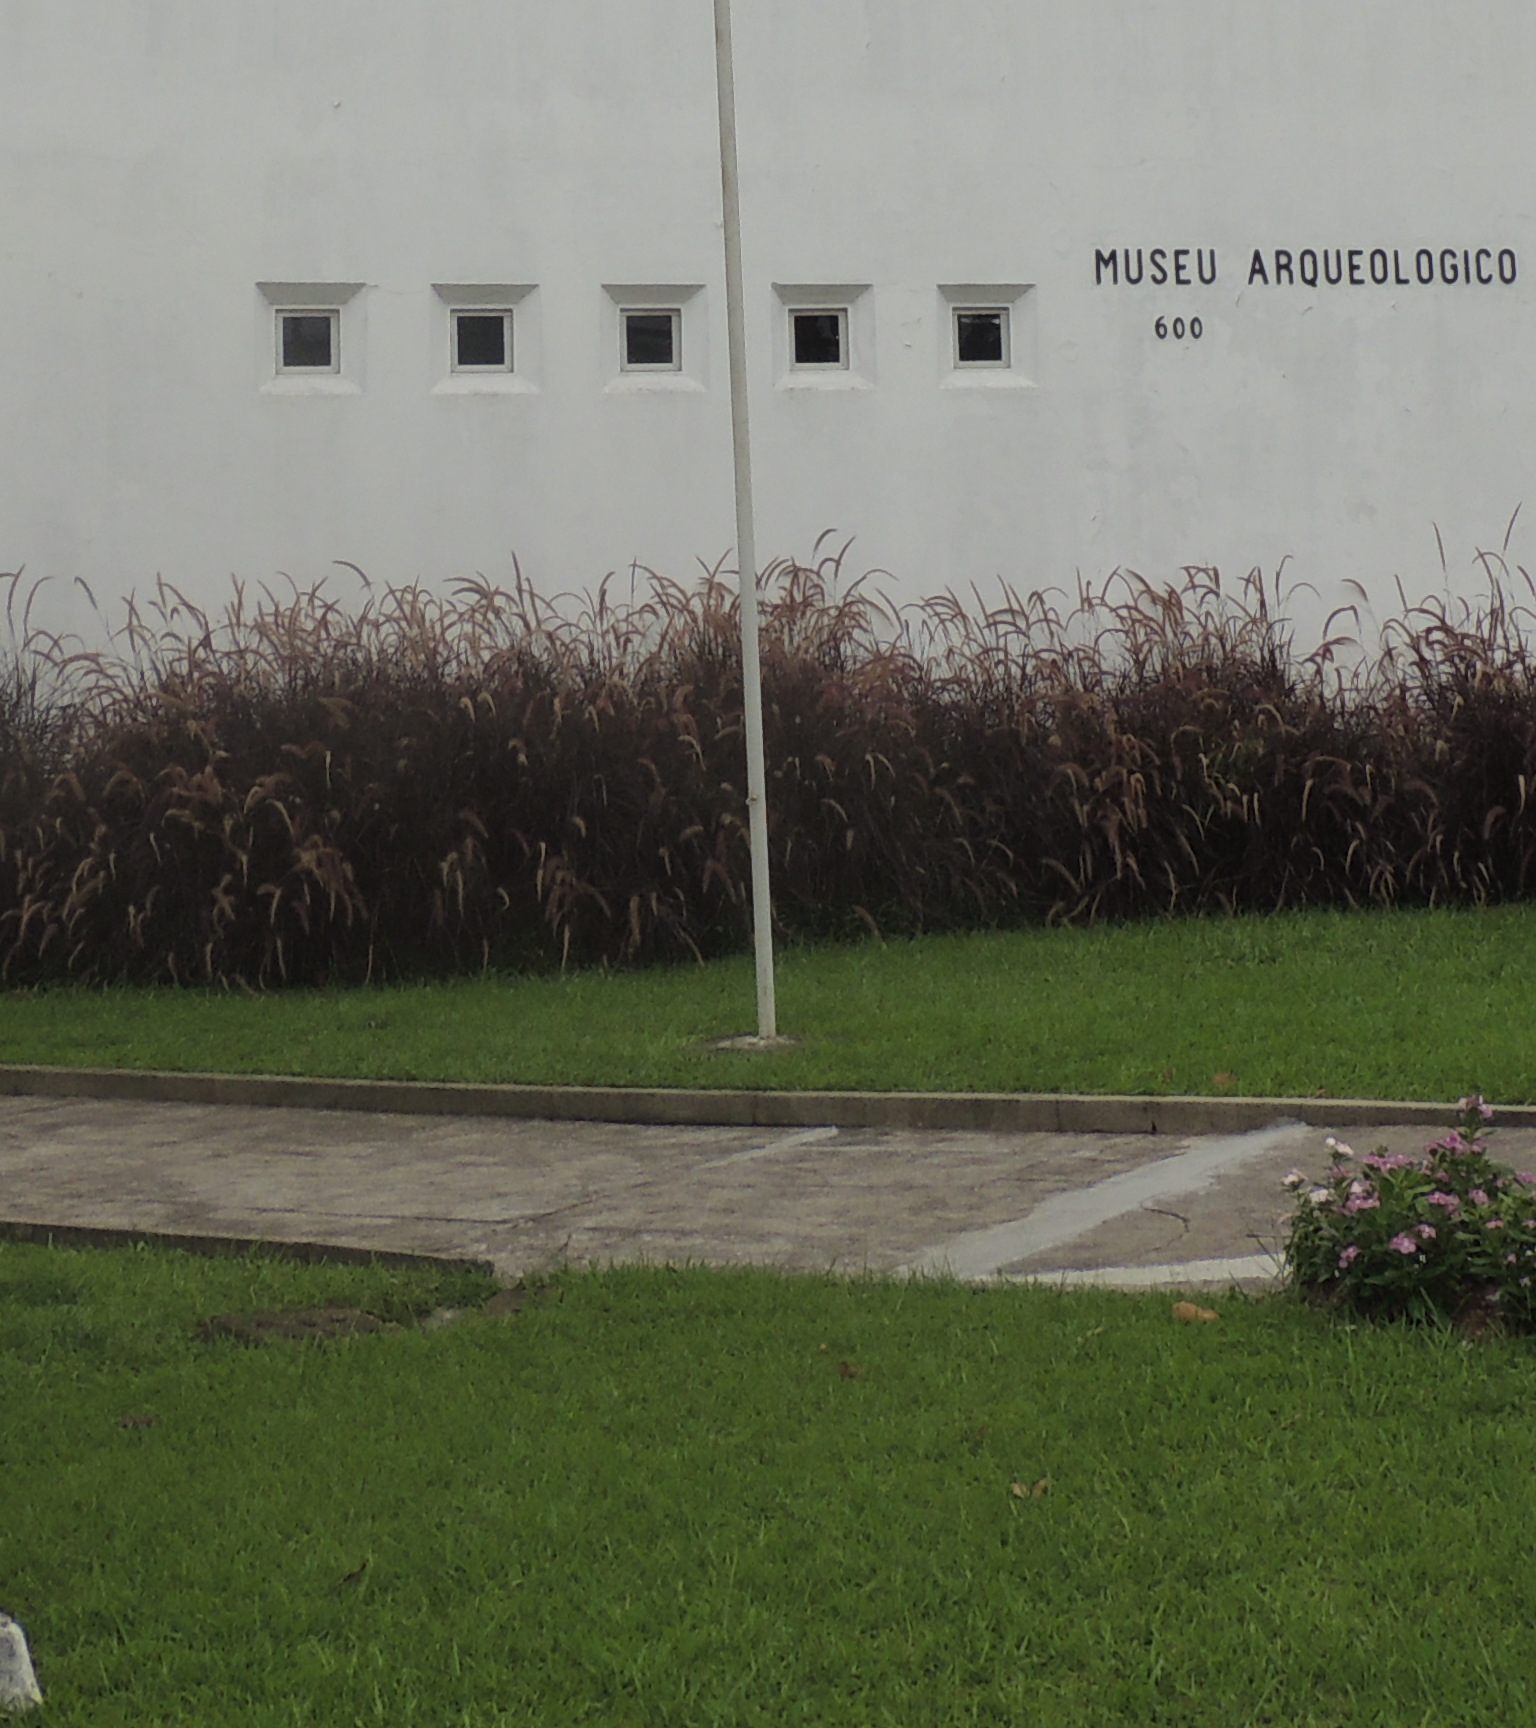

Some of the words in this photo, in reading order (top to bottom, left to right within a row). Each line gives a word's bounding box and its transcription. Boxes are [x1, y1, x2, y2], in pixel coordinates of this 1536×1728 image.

[1094, 248, 1217, 286] MUSEU
[1247, 248, 1517, 288] ARQUEOLOGICO
[1154, 315, 1203, 340] 600
